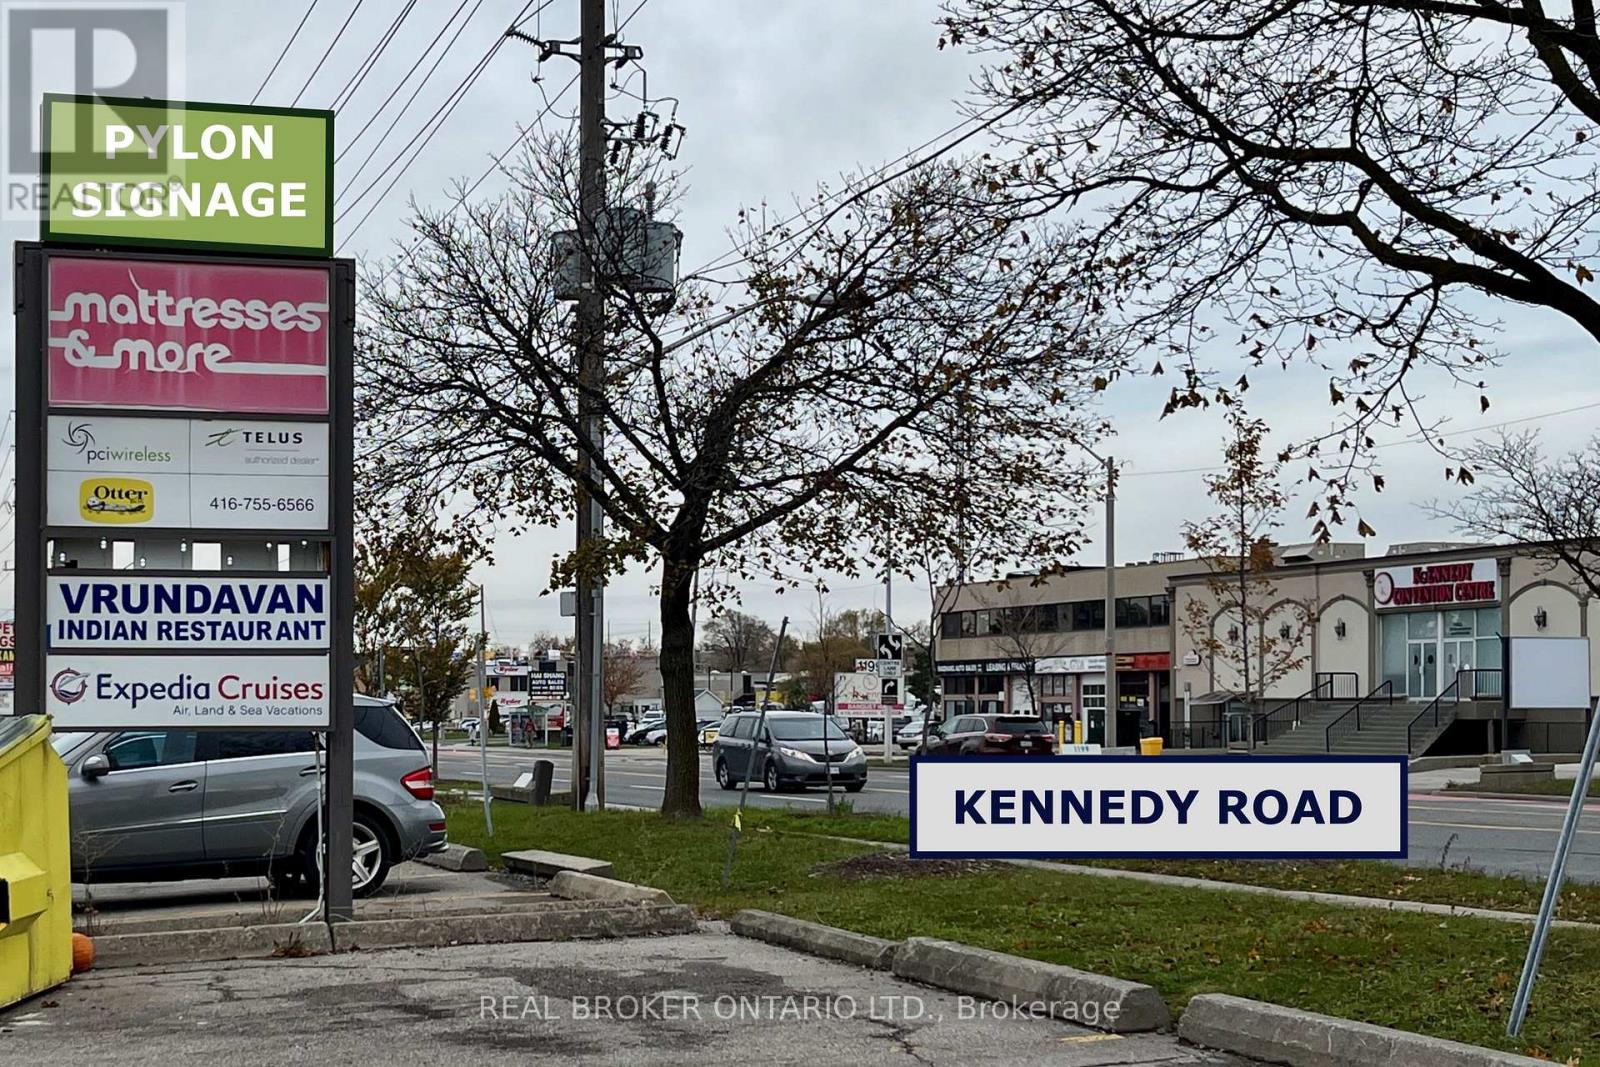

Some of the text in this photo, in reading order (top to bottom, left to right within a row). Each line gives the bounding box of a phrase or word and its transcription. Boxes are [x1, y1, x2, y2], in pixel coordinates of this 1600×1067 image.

[56, 281, 327, 332] mattresses
[62, 329, 242, 373] & more
[242, 431, 303, 445] TELUS
[87, 446, 171, 464] pciwireless
[244, 456, 289, 465] authorized
[94, 485, 148, 500] Otter
[209, 496, 315, 512] 416-755-6566
[59, 583, 324, 614] VRUNDAVAN
[58, 619, 326, 642] INDIAN RESTAURANT
[96, 673, 324, 709] Expedia Cruises
[173, 705, 323, 717] Air, Land & Sea Vacations
